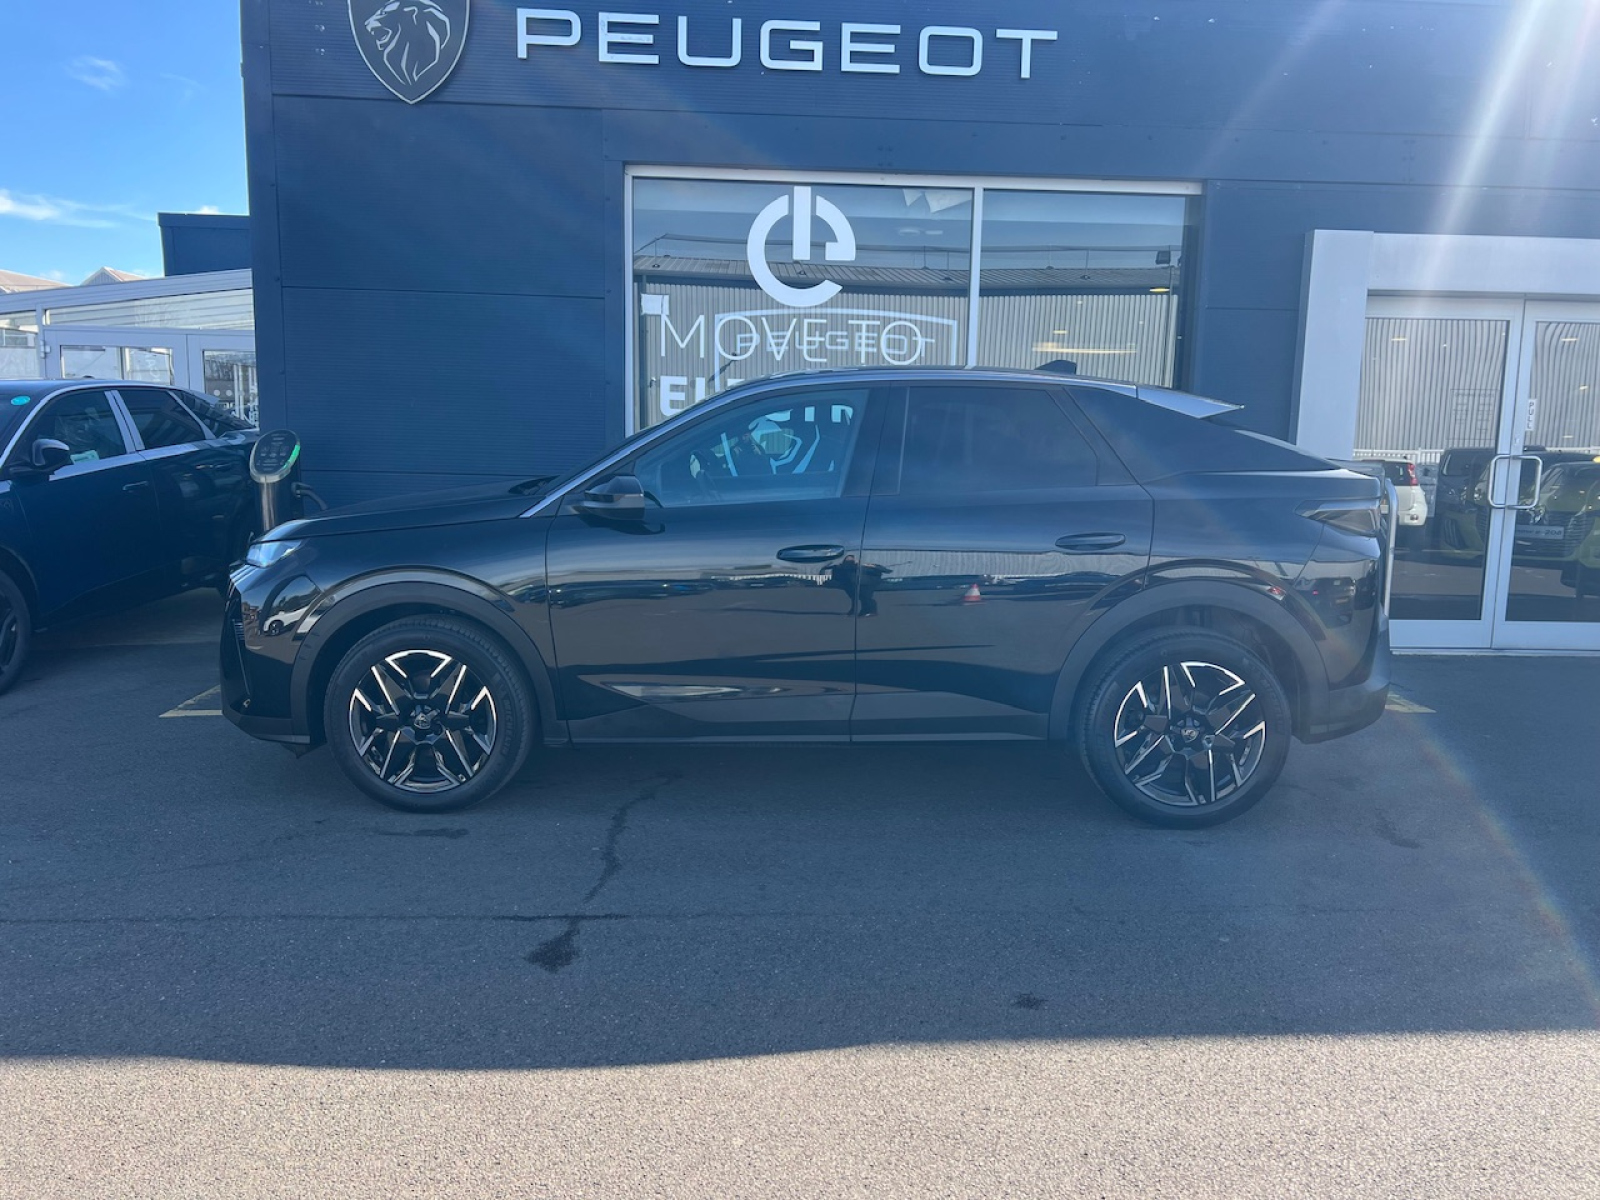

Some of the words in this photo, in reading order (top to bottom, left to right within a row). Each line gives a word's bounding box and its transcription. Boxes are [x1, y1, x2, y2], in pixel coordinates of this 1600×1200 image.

[516, 7, 1058, 79] PEUGEOT
[660, 314, 828, 362] MOVE
[848, 319, 923, 366] TO
[735, 331, 936, 357] PEUGEOT
[1526, 401, 1535, 430] PULL
